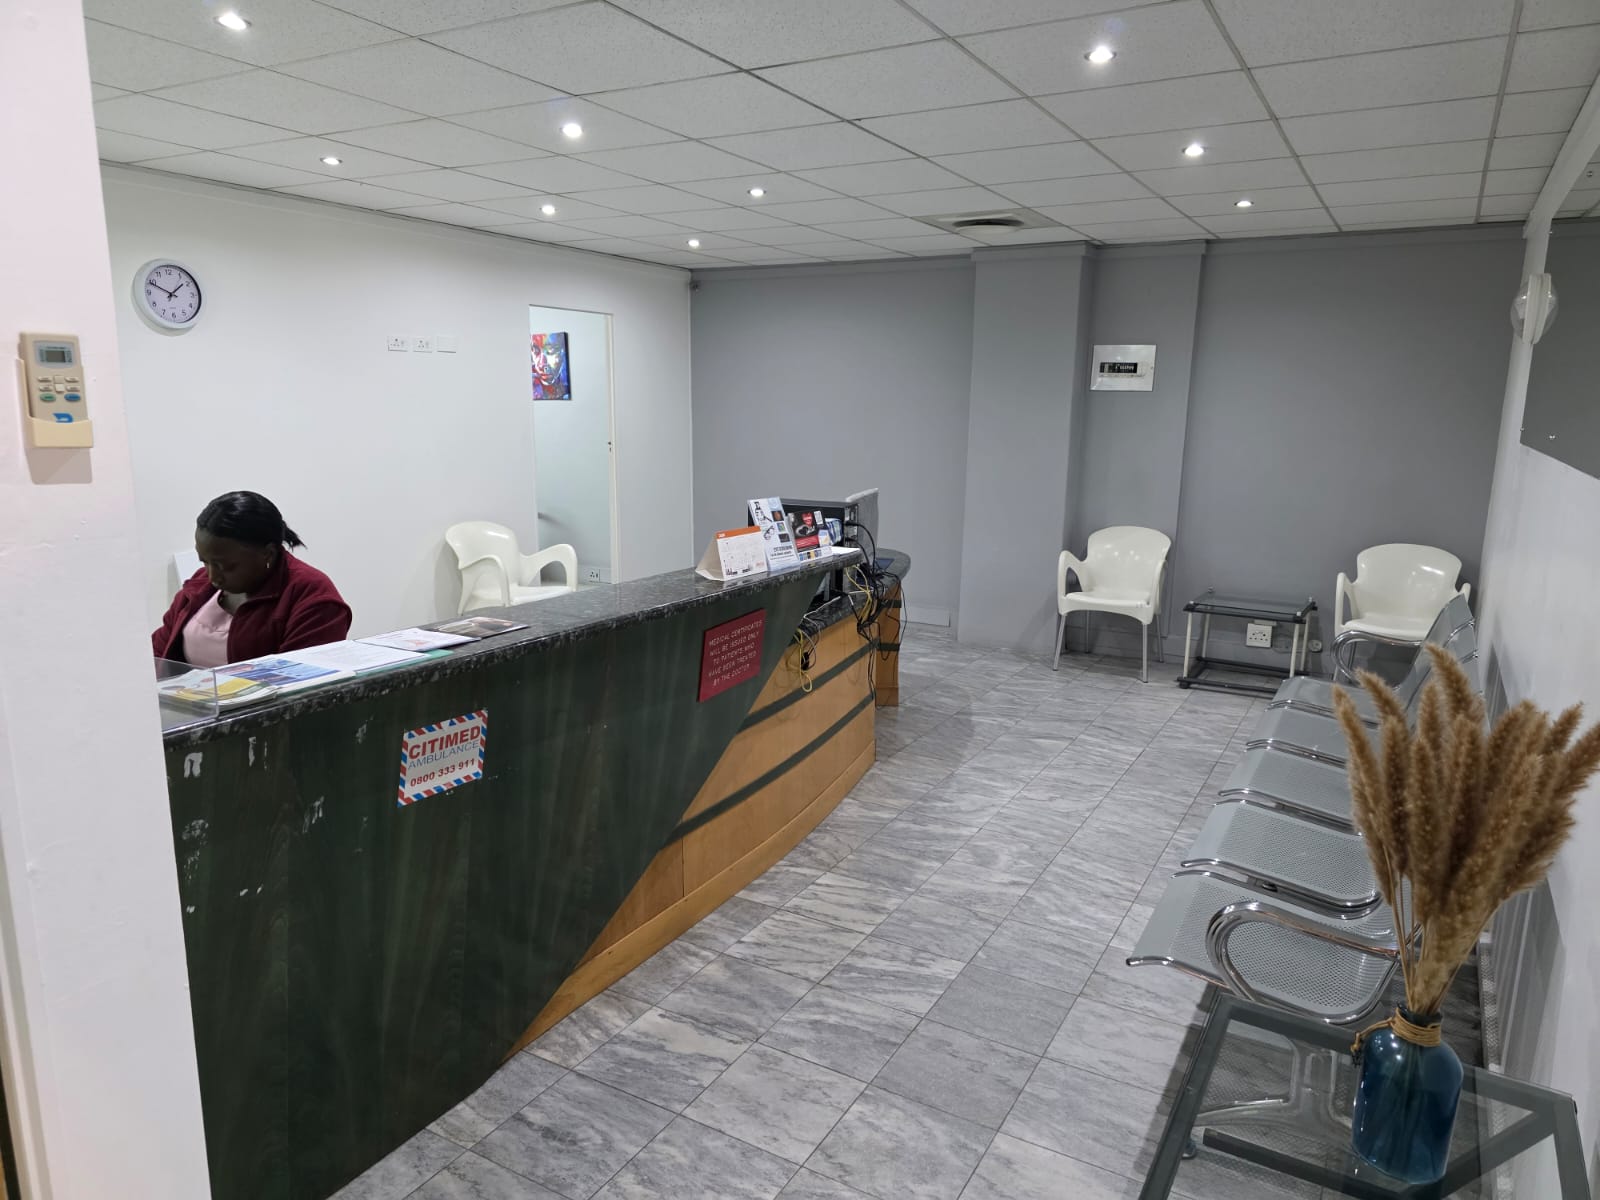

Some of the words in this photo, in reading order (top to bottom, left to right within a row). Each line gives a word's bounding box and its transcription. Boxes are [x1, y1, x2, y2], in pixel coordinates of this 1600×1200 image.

[709, 634, 730, 646] MEDICAL
[731, 620, 763, 638] CERTIFICATES
[710, 647, 721, 656] WILL
[722, 643, 729, 651] BE
[731, 636, 747, 648] ISSUED
[747, 631, 759, 641] ONLY
[708, 666, 721, 677] HAVE
[722, 661, 735, 671] BEEN
[736, 650, 757, 663] TREATED
[713, 657, 720, 665] TO
[721, 647, 743, 661] PATIENTS
[744, 642, 755, 651] WHO
[713, 678, 720, 687] BY
[721, 672, 731, 681] THE
[408, 725, 481, 760] CITIMED
[408, 740, 480, 770] AMBULANCE
[410, 771, 435, 787] 0800
[437, 764, 456, 777] 333
[458, 758, 475, 770] 911
